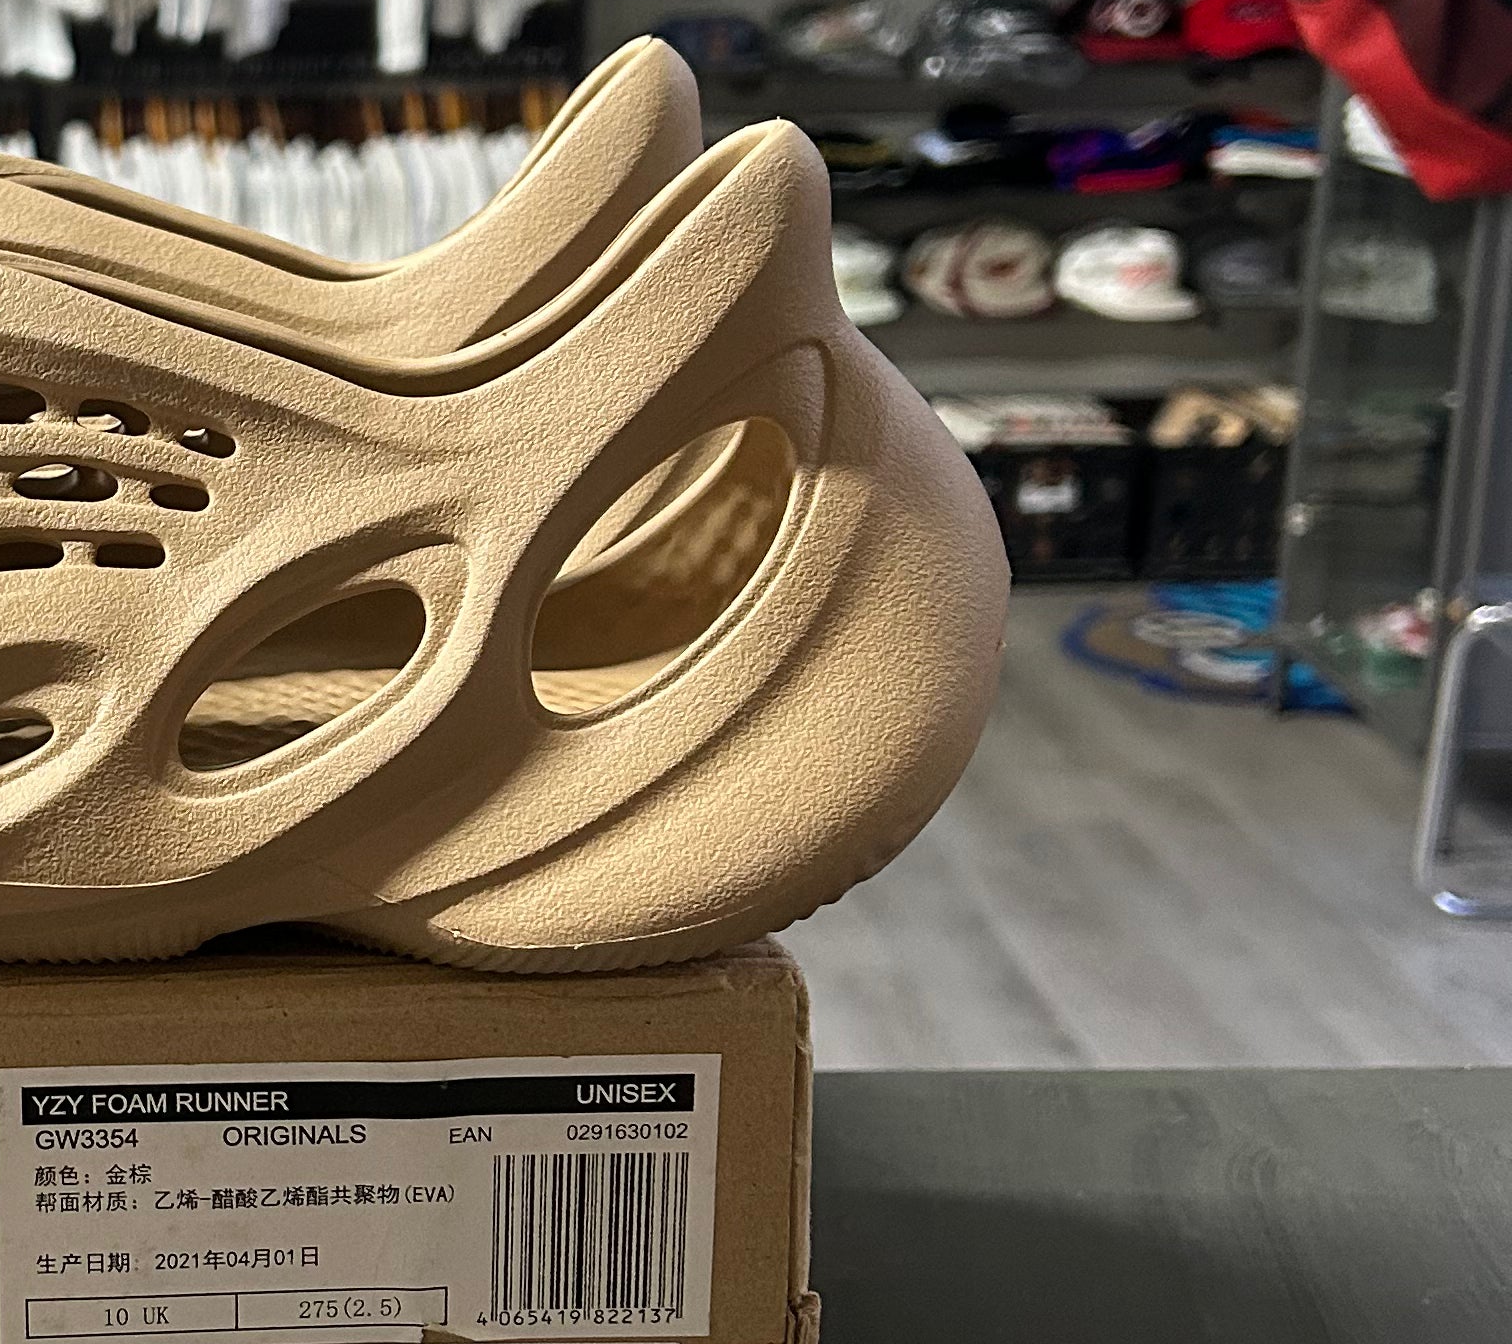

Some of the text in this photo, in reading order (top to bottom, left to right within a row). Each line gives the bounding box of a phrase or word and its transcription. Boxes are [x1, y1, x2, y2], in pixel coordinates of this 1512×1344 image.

[31, 1090, 290, 1116] YZY FOAM RUNNER
[576, 1082, 677, 1104] UNISEX
[34, 1127, 139, 1151] GW3354
[222, 1123, 367, 1147] ORIGINALS
[449, 1126, 493, 1144] EAN
[566, 1122, 689, 1141] 0291630102
[104, 1306, 170, 1327] 10 UK
[298, 1295, 404, 1320] 275(2.5)
[476, 1307, 676, 1326] 4 065419 822137
